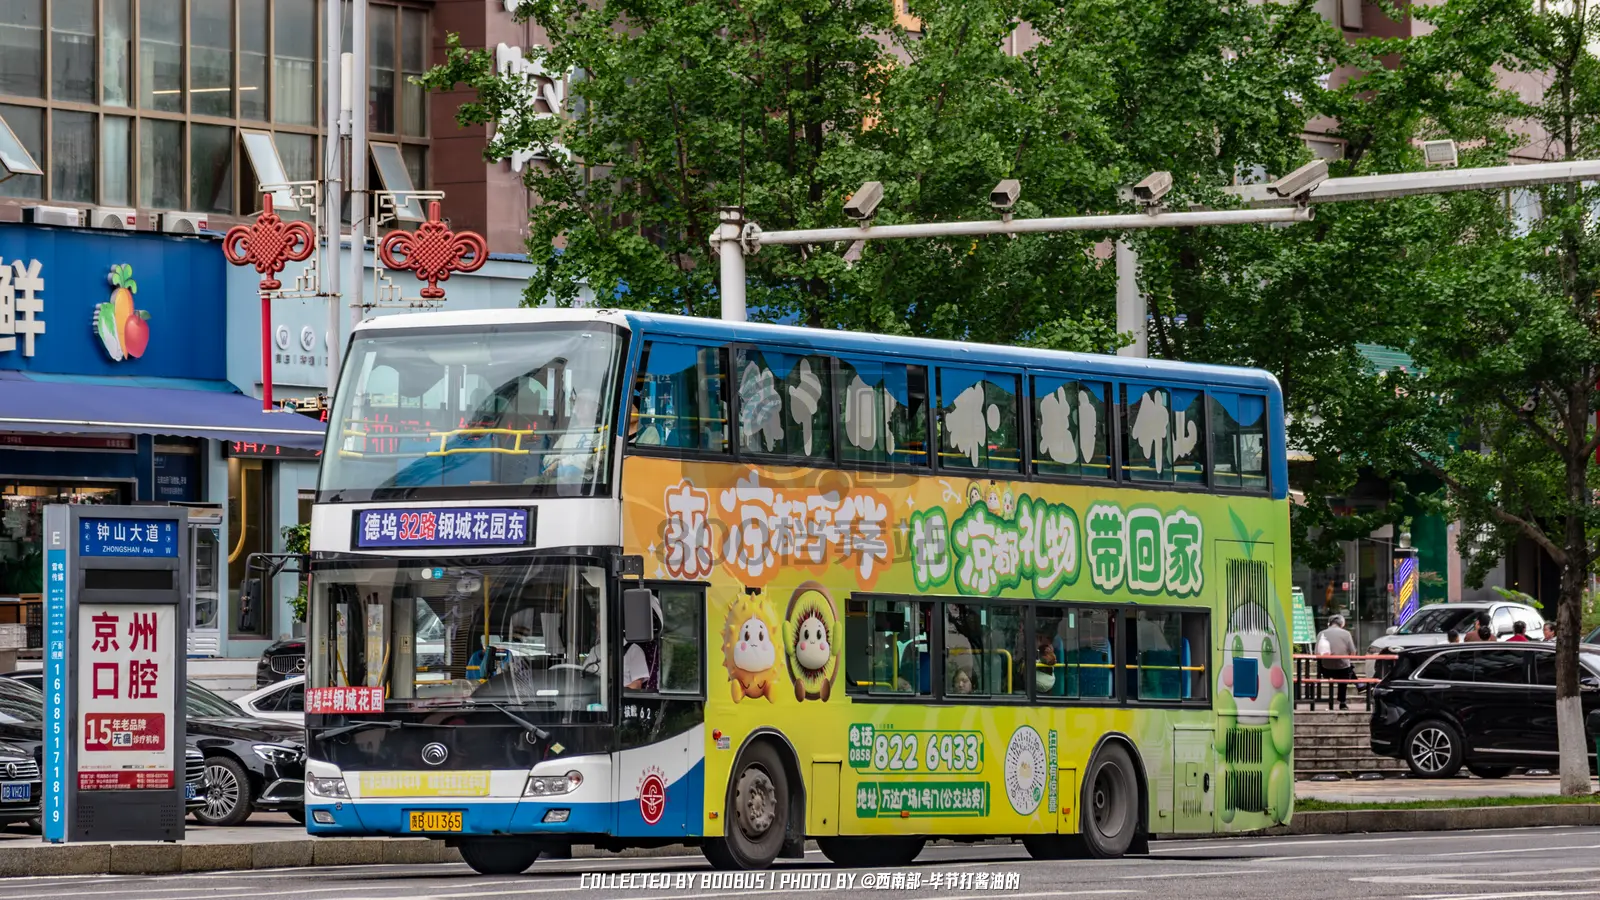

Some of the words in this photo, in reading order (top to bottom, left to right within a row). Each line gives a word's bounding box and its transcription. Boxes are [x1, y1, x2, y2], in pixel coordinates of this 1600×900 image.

[52, 532, 60, 545] E
[97, 522, 160, 543] 钟山大道
[85, 545, 90, 553] E
[102, 545, 140, 553] ZHONGSHAN
[91, 611, 158, 652] 京州
[91, 659, 159, 699] 口腔
[86, 719, 112, 744] 15
[850, 725, 873, 747] 电话
[850, 749, 871, 761] 0858
[875, 733, 919, 770] 822
[926, 733, 979, 771] 6933
[857, 787, 877, 809] 地址
